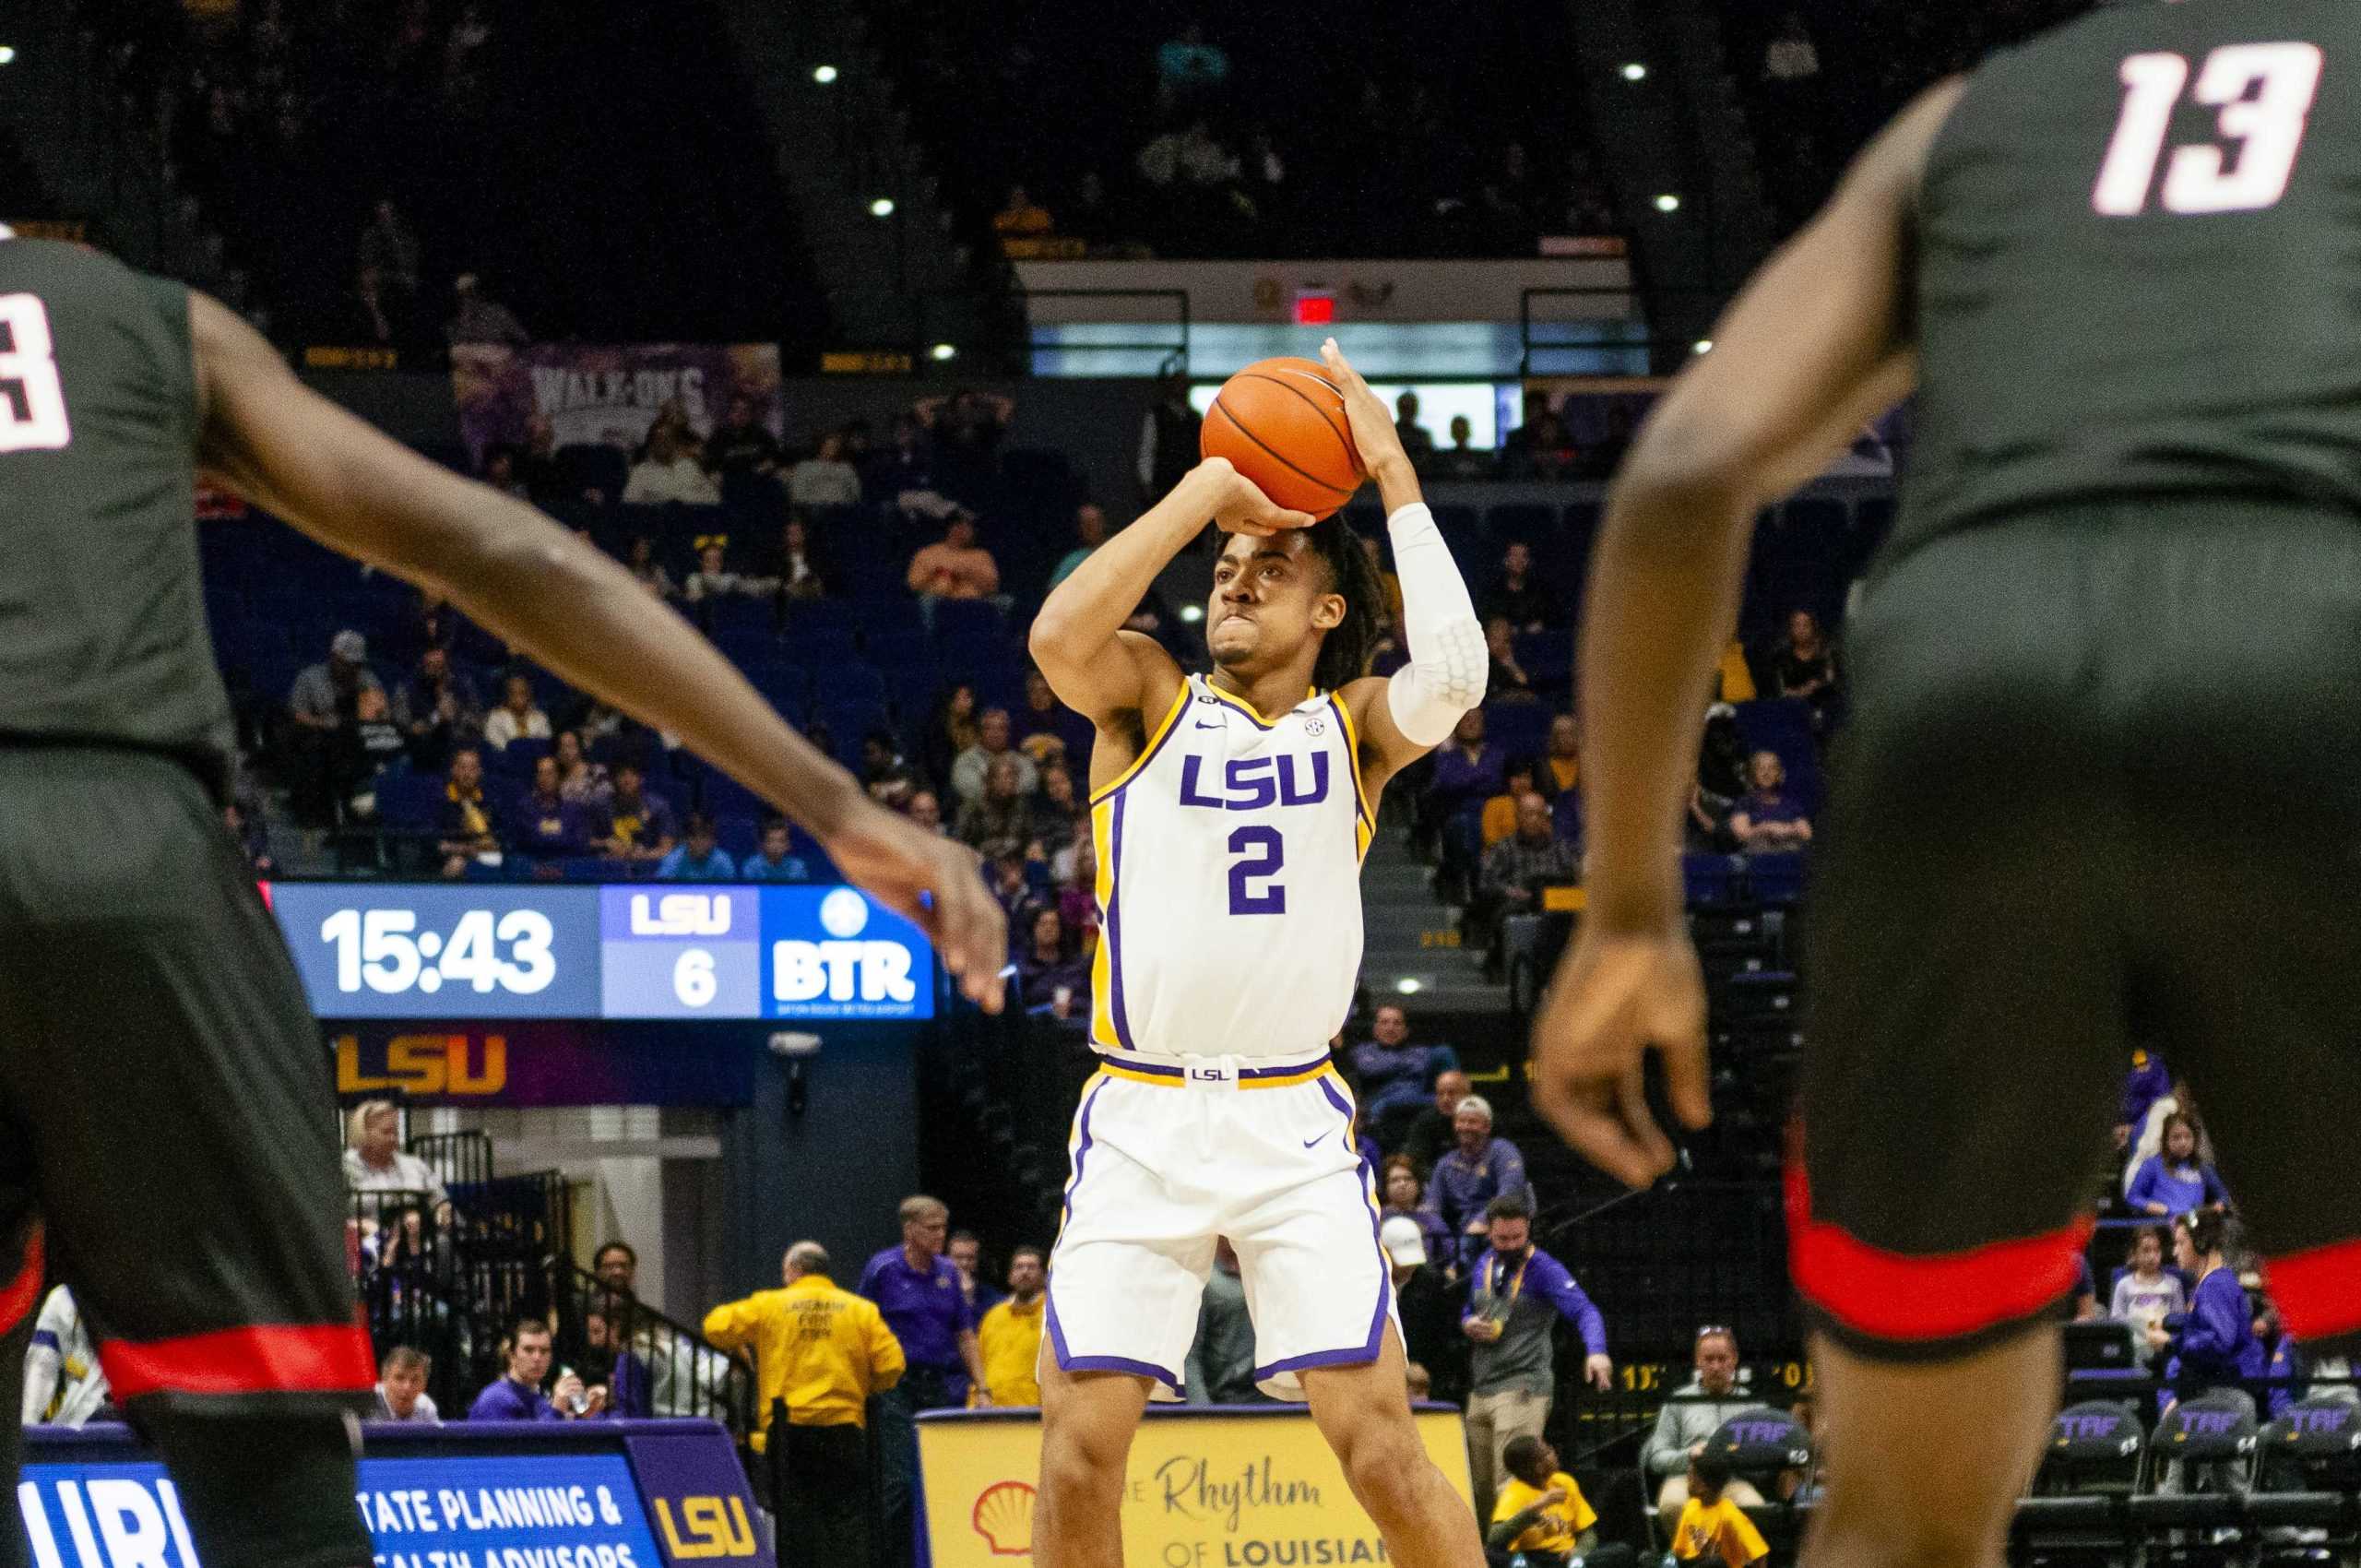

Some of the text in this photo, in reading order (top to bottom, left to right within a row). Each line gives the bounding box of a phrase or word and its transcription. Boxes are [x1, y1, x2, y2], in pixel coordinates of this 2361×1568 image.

[2091, 40, 2325, 216] 13
[1180, 751, 1329, 811] LSU
[1228, 825, 1287, 916] 2
[631, 895, 731, 934] LSU
[321, 909, 556, 994] 15:43
[674, 948, 718, 1007] 6
[773, 940, 916, 1003] BTR
[337, 1034, 507, 1095] LSU
[438, 1485, 595, 1530] PLANNING
[597, 1485, 623, 1526] &
[1155, 1455, 1322, 1534] Rhythm
[654, 1494, 757, 1560] LSU
[1163, 1540, 1208, 1568] OF
